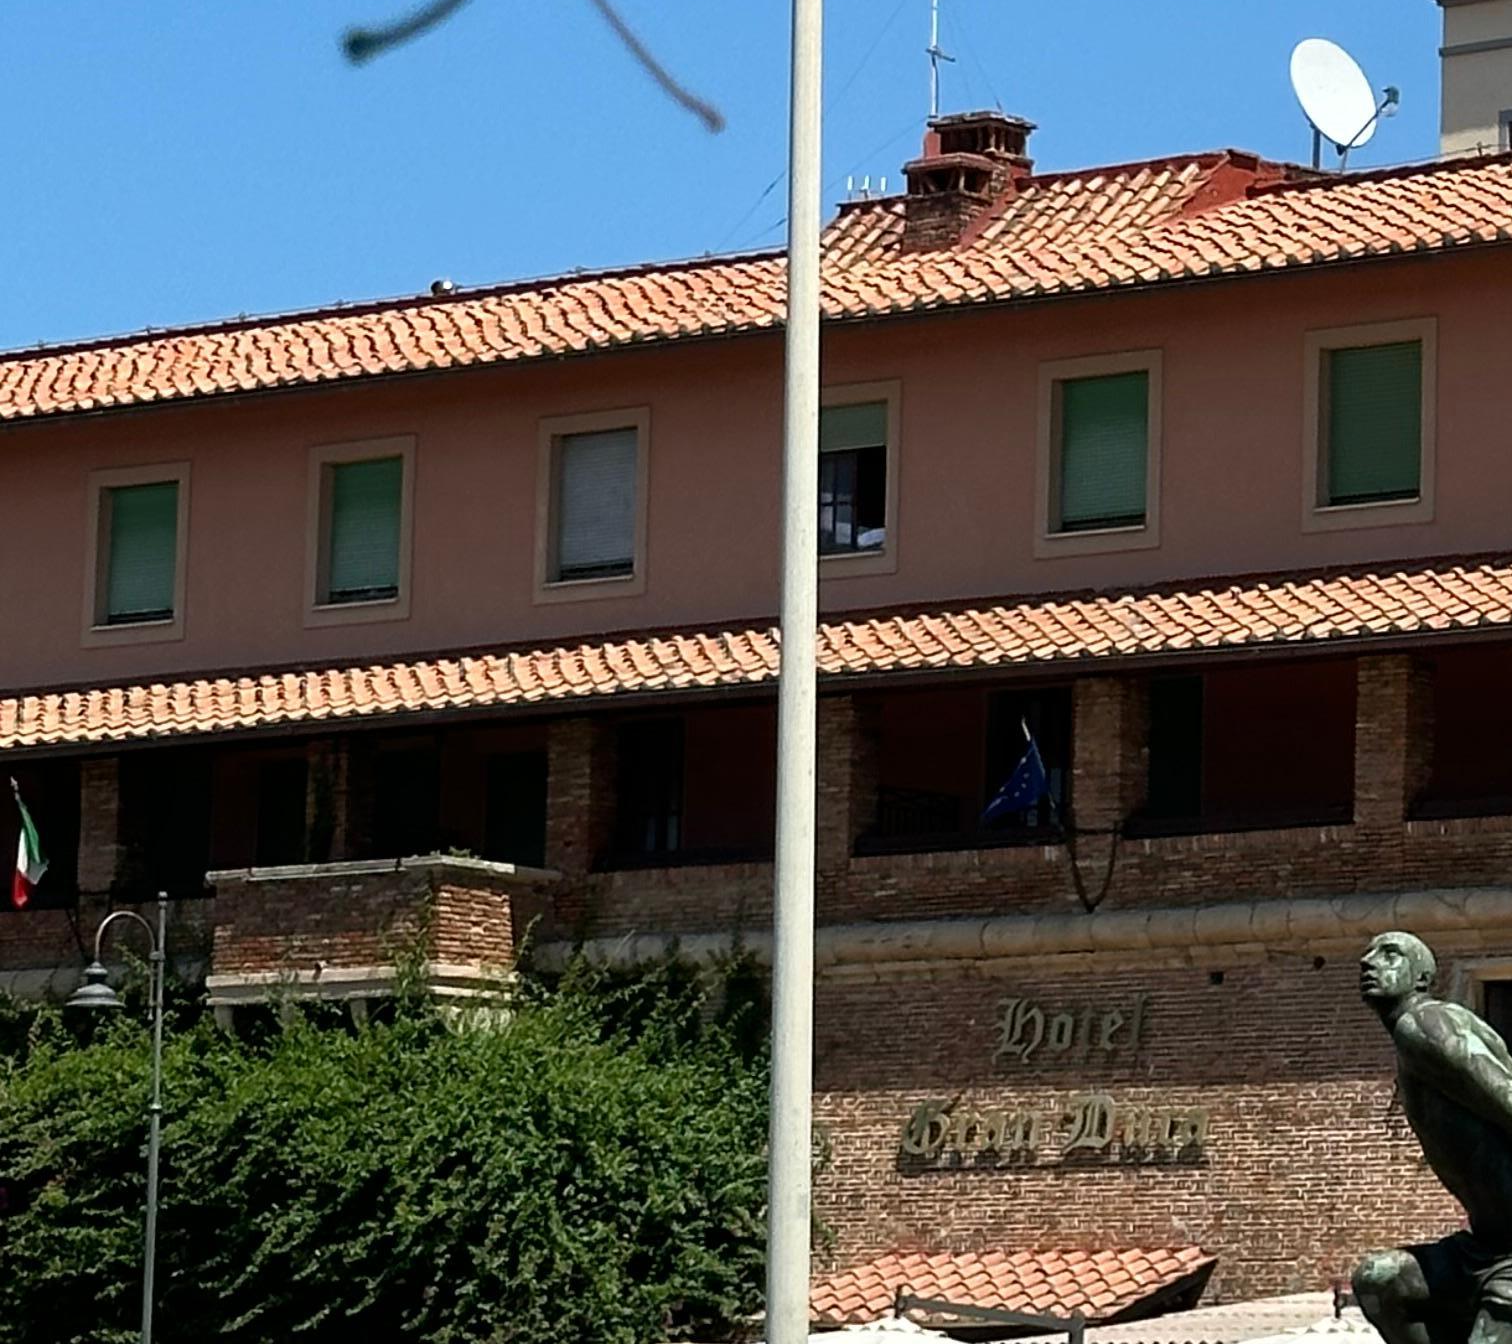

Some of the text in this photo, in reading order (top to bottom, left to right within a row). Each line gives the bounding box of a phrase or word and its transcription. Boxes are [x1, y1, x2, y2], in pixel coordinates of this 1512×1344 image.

[992, 993, 1150, 1064] Hotel
[902, 1094, 1208, 1156] Gran Duca
